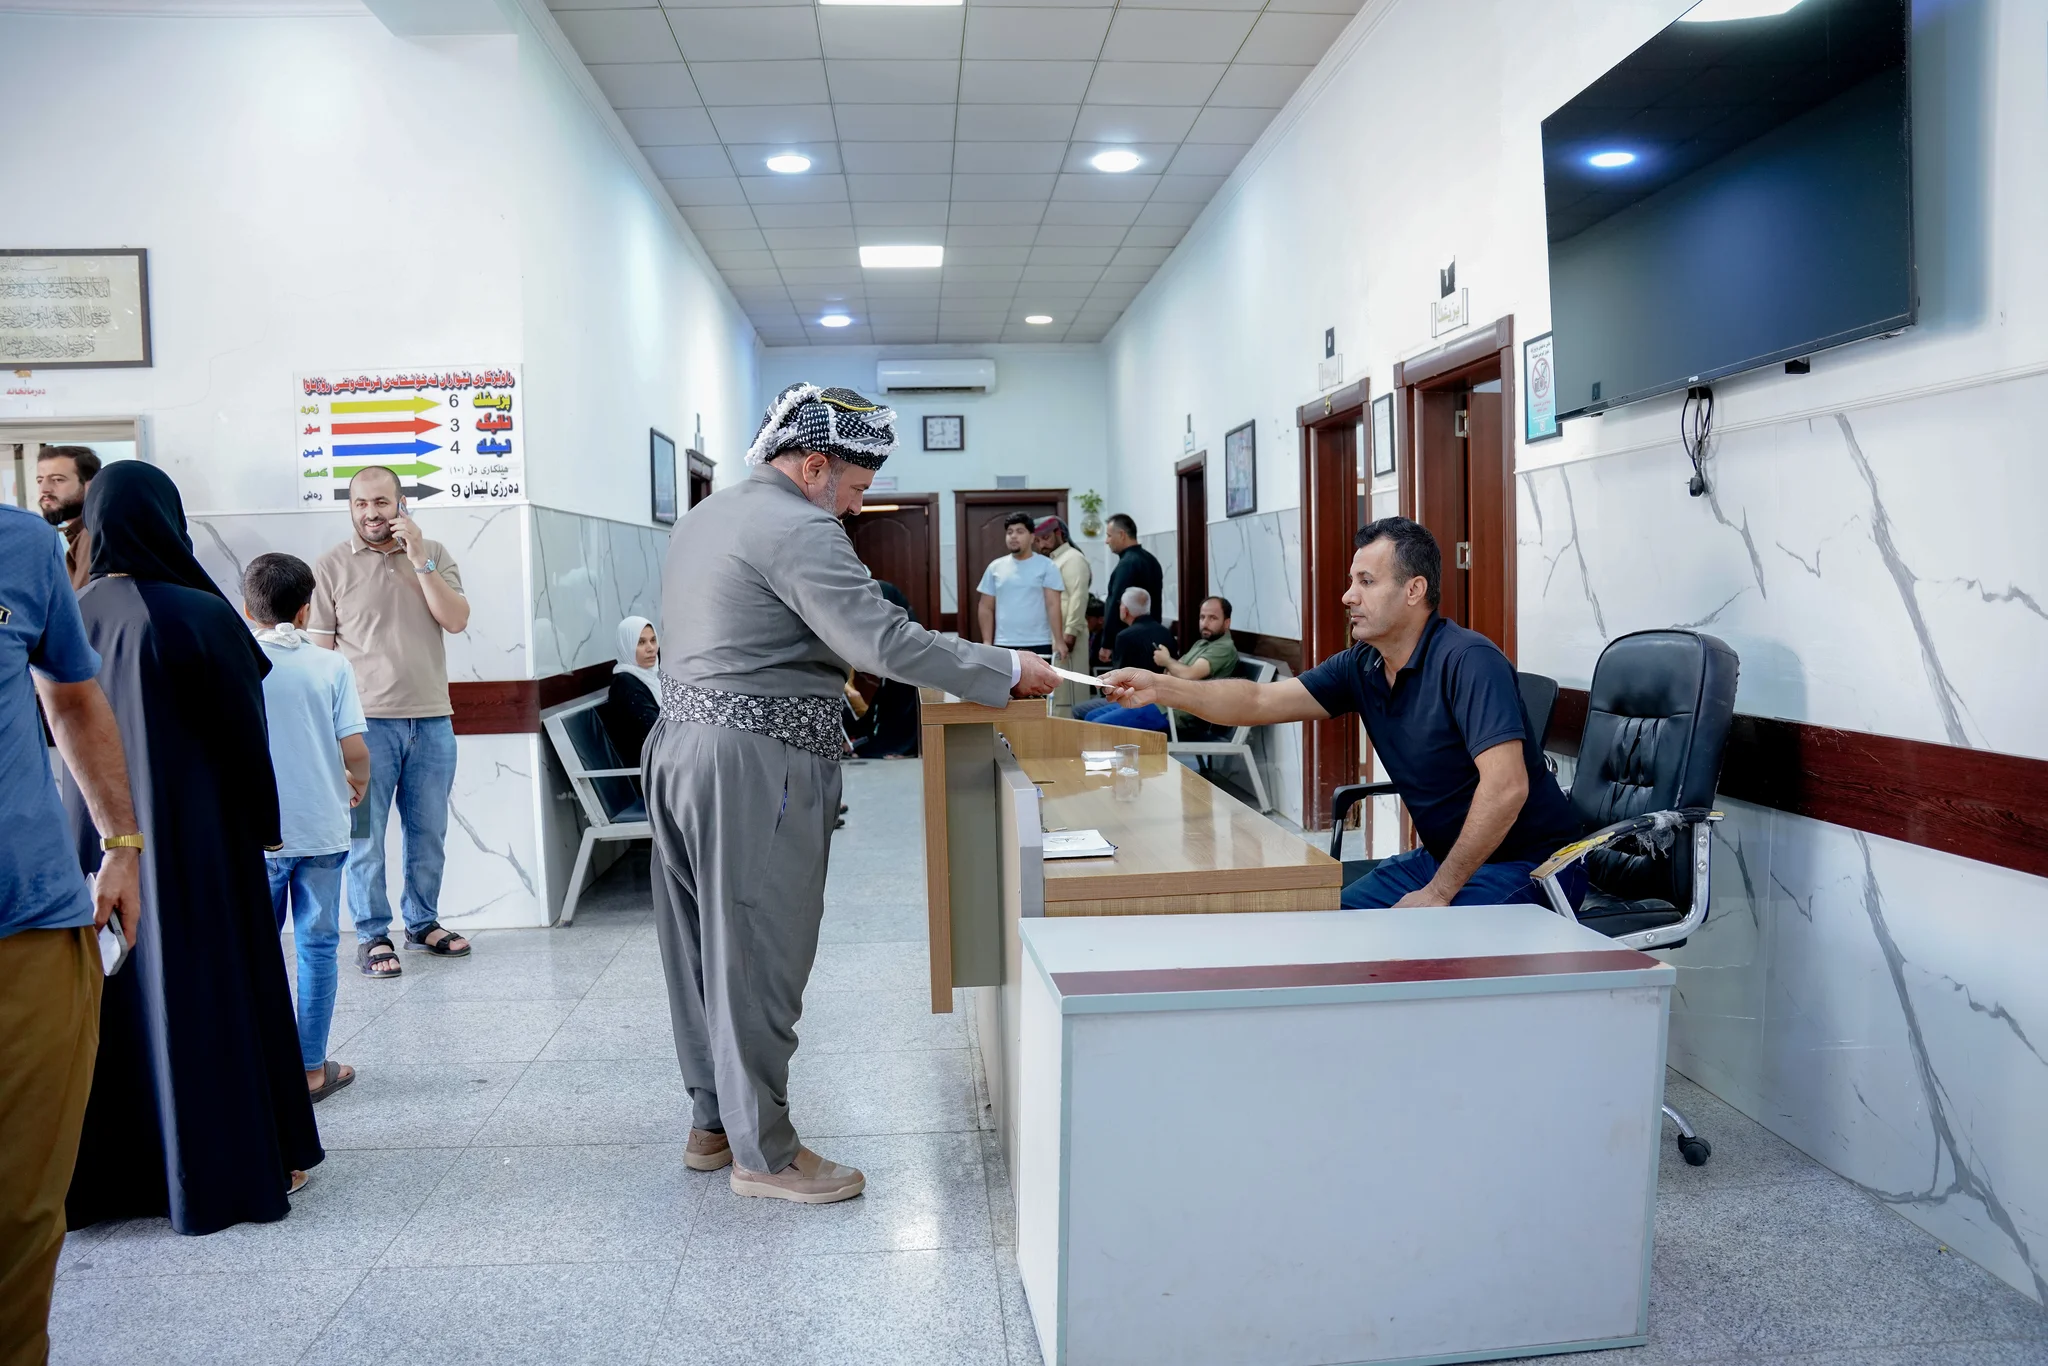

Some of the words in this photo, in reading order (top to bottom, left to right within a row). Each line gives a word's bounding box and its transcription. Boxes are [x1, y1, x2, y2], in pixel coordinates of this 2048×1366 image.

[449, 394, 459, 408] 6
[1324, 394, 1332, 415] 5
[450, 418, 460, 432] 3
[302, 446, 323, 458] شین
[450, 440, 461, 455] 4
[451, 483, 461, 498] 9
